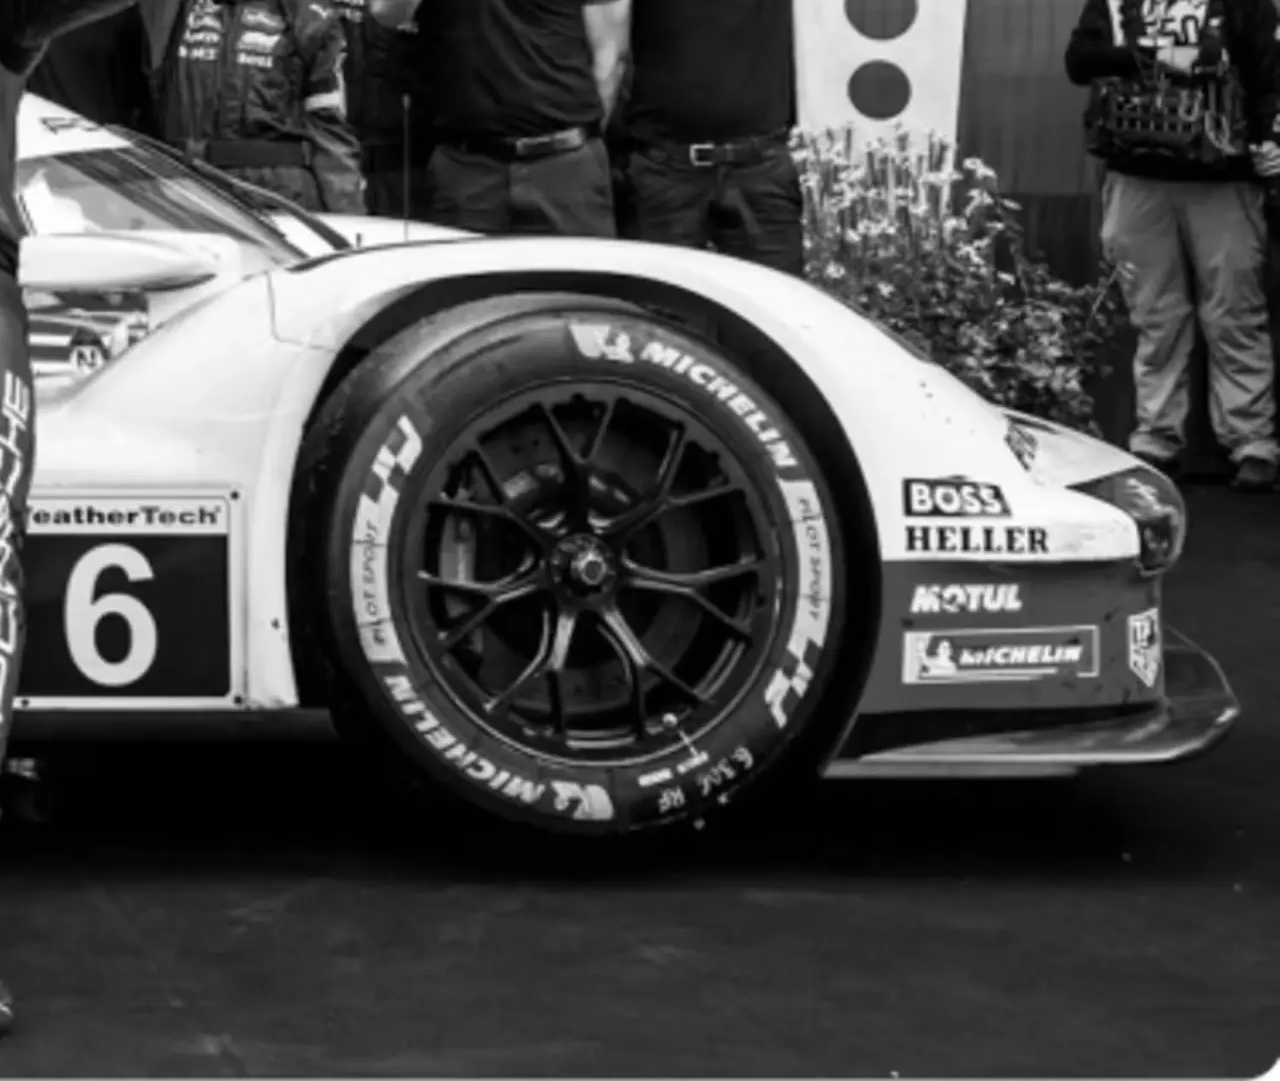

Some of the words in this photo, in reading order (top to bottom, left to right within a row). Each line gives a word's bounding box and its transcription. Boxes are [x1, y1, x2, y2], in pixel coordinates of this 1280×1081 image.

[640, 340, 798, 468] MICHELIN
[910, 482, 1003, 515] BOSS
[28, 505, 220, 525] eatherTech
[905, 525, 1050, 554] HELLER
[910, 583, 1023, 614] MOTUL
[63, 542, 158, 688] 6
[959, 644, 1084, 666] MICHELIN
[383, 674, 546, 804] MICHELIN
